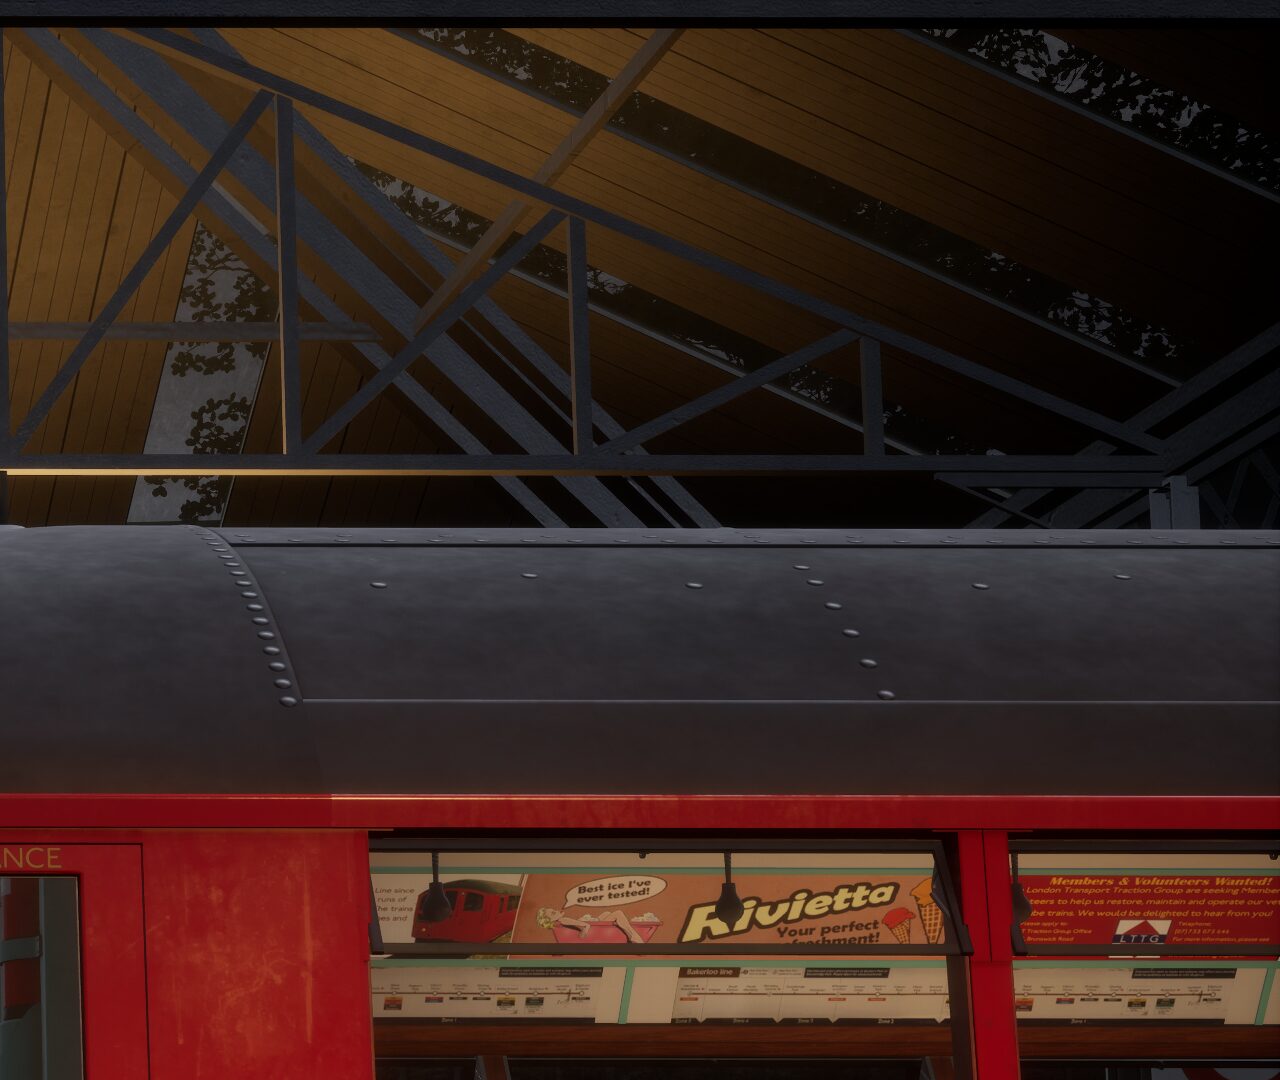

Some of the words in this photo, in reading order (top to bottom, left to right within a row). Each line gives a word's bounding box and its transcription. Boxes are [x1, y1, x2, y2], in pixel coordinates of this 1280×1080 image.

[1049, 877, 1115, 886] Members
[1118, 877, 1130, 886] &
[1135, 877, 1210, 886] Volunteers
[1215, 877, 1273, 886] Wanted!
[578, 884, 604, 894] Best
[608, 883, 625, 891] ice
[628, 880, 651, 889] I've
[1064, 887, 1110, 895] Transport
[1154, 887, 1184, 895] Group
[1203, 887, 1239, 896] seeking
[577, 895, 604, 903] ever
[608, 888, 650, 900] tested!
[1070, 898, 1091, 906] help
[1207, 899, 1245, 907] operate
[680, 884, 896, 943] Rivietta
[1142, 910, 1189, 918] delighted
[1251, 910, 1274, 918] you!
[777, 927, 816, 938] Your
[820, 919, 880, 936] perfect
[1119, 934, 1159, 943] LTTG
